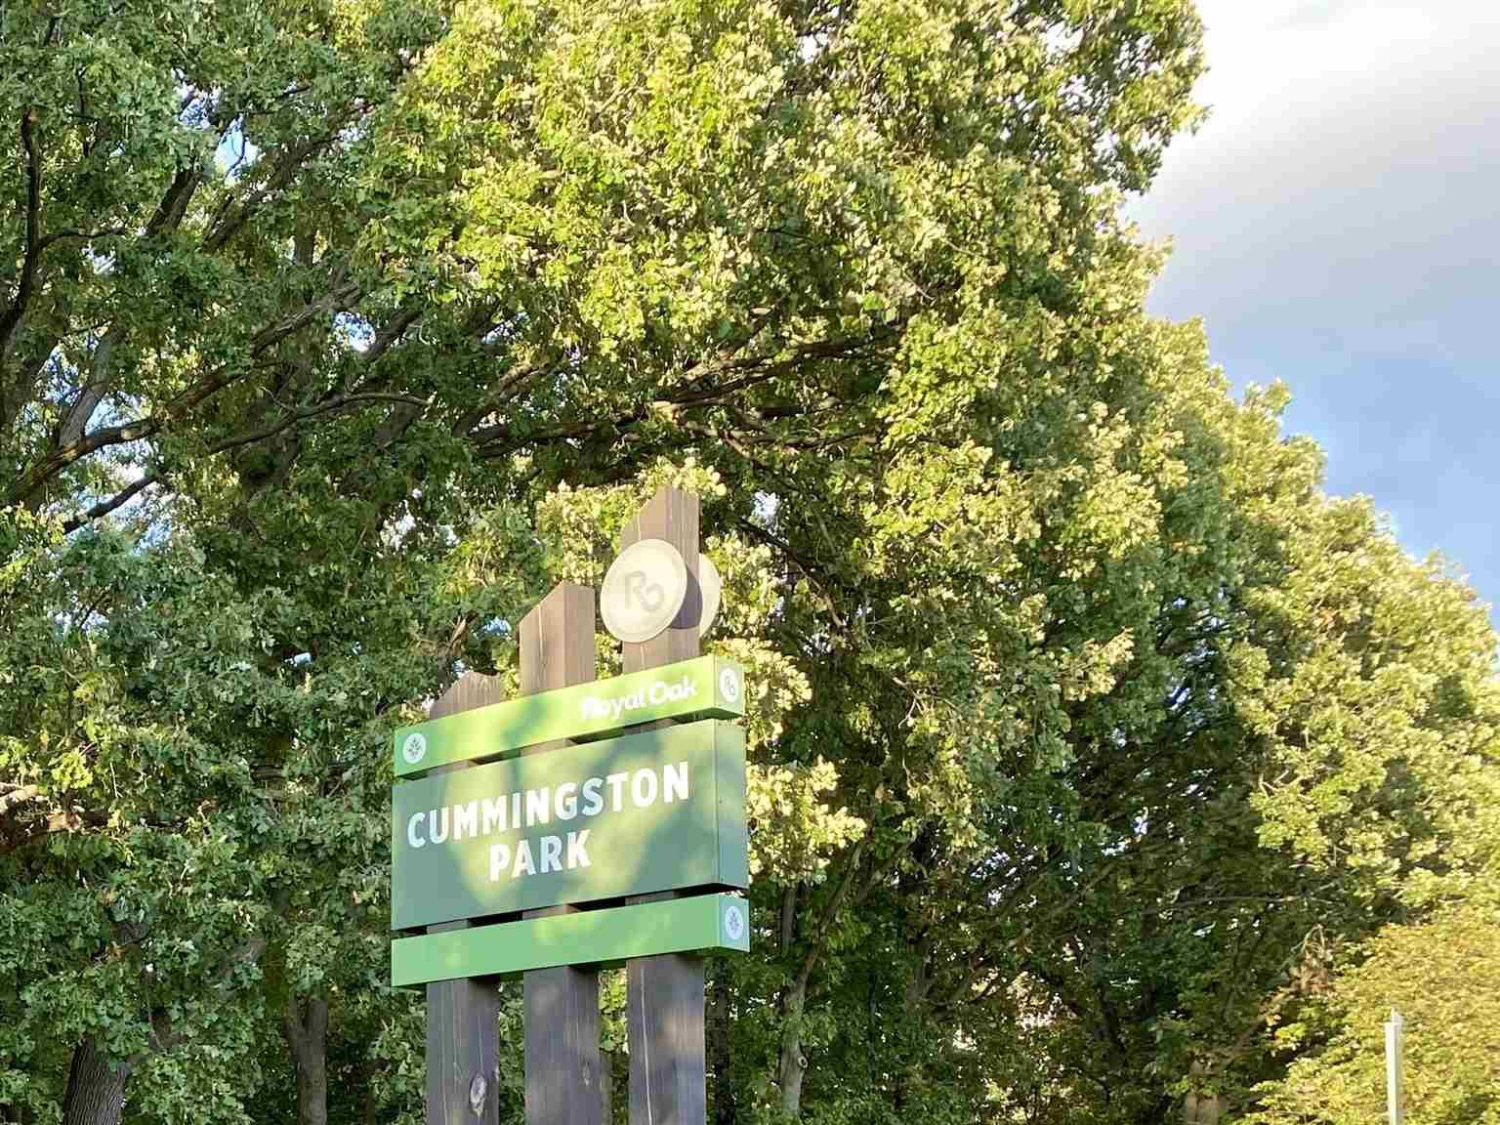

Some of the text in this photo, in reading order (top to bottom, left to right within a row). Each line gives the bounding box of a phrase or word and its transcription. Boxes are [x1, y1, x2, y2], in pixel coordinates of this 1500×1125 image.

[649, 675, 696, 705] Oak
[407, 761, 689, 848] CUMMINGSTON
[489, 829, 592, 882] PARK
